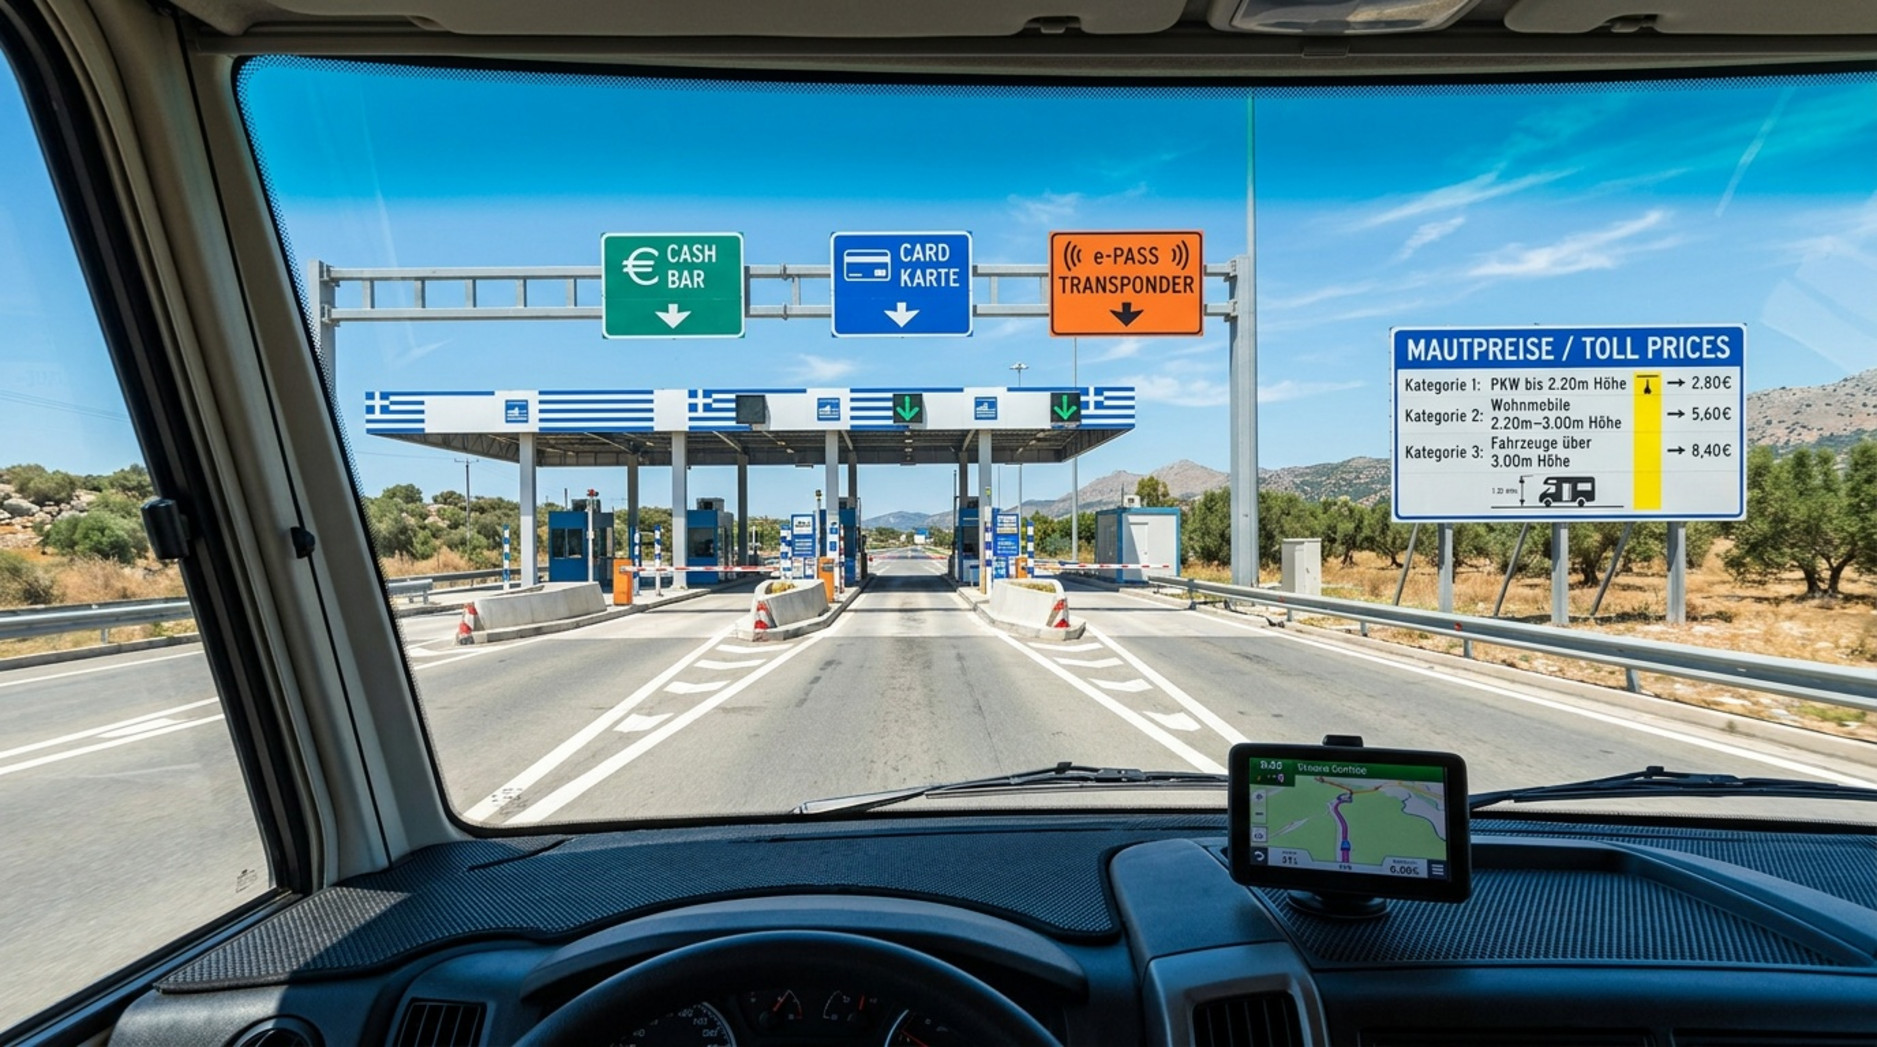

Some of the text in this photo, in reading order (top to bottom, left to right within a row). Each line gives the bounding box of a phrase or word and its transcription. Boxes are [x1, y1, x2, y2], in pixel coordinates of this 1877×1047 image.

[666, 244, 717, 264] CASH
[899, 243, 950, 263] CARD
[1093, 247, 1160, 266] e-PASS
[667, 270, 705, 289] BAR
[900, 269, 960, 288] KARTE
[1057, 275, 1195, 295] TRANSPONDER
[1407, 336, 1731, 361] MAUTPREISE / TOLL PRICES
[1405, 377, 1627, 395] Kategorie 1: PKW bis 2.20m Höhe
[1691, 376, 1732, 390] 2.80€
[1405, 409, 1484, 426] Kategorie 2:
[1588, 416, 1622, 430] Höhe
[1692, 407, 1732, 422] 5,60€
[1491, 436, 1592, 453] Fahrzeuge über
[1691, 443, 1732, 459] 8,40€
[1405, 445, 1484, 463] Kategorie 3:
[1490, 454, 1571, 469] 3.00m Höhe
